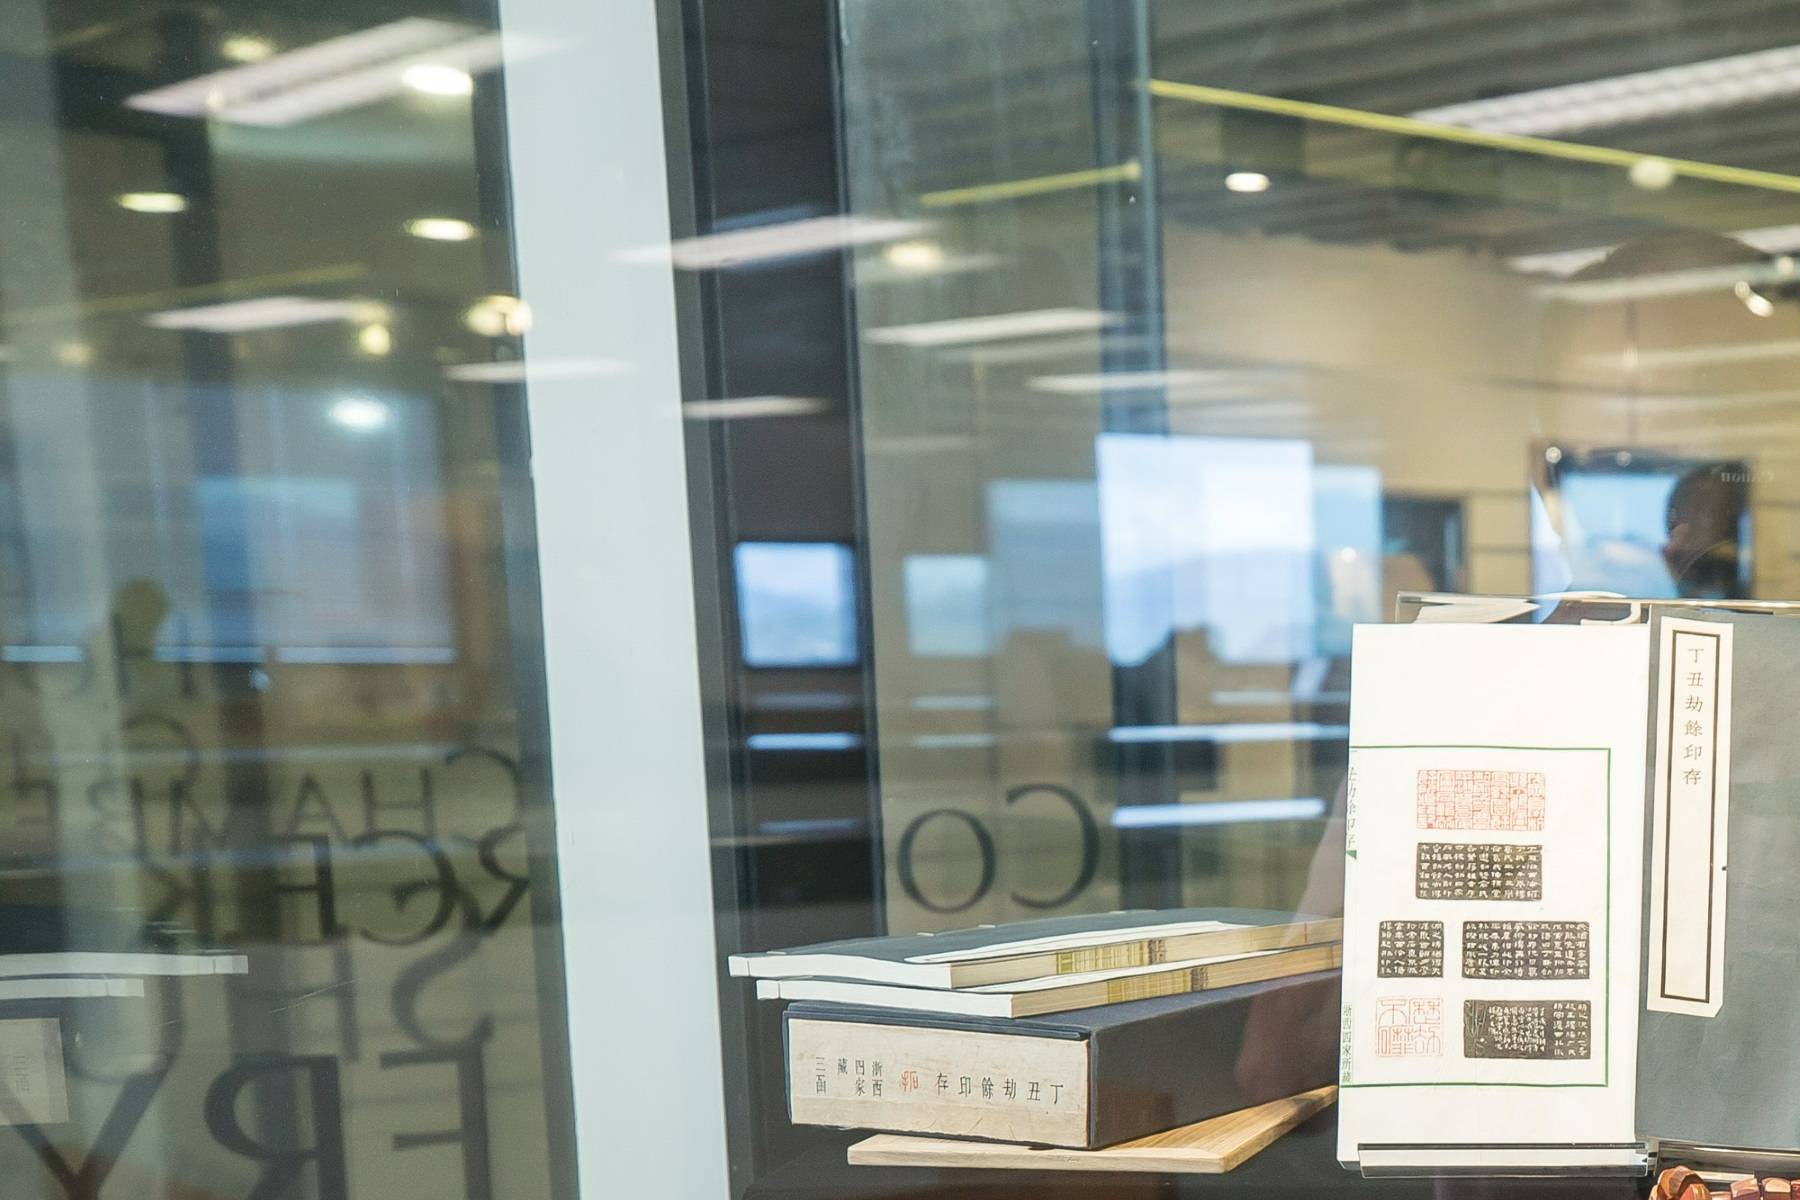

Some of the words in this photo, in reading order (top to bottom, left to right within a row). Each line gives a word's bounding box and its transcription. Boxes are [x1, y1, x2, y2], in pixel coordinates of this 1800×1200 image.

[1683, 648, 1704, 785] 丁丑劫餘印存
[935, 1072, 1064, 1105] 丁丑劫餘印存
